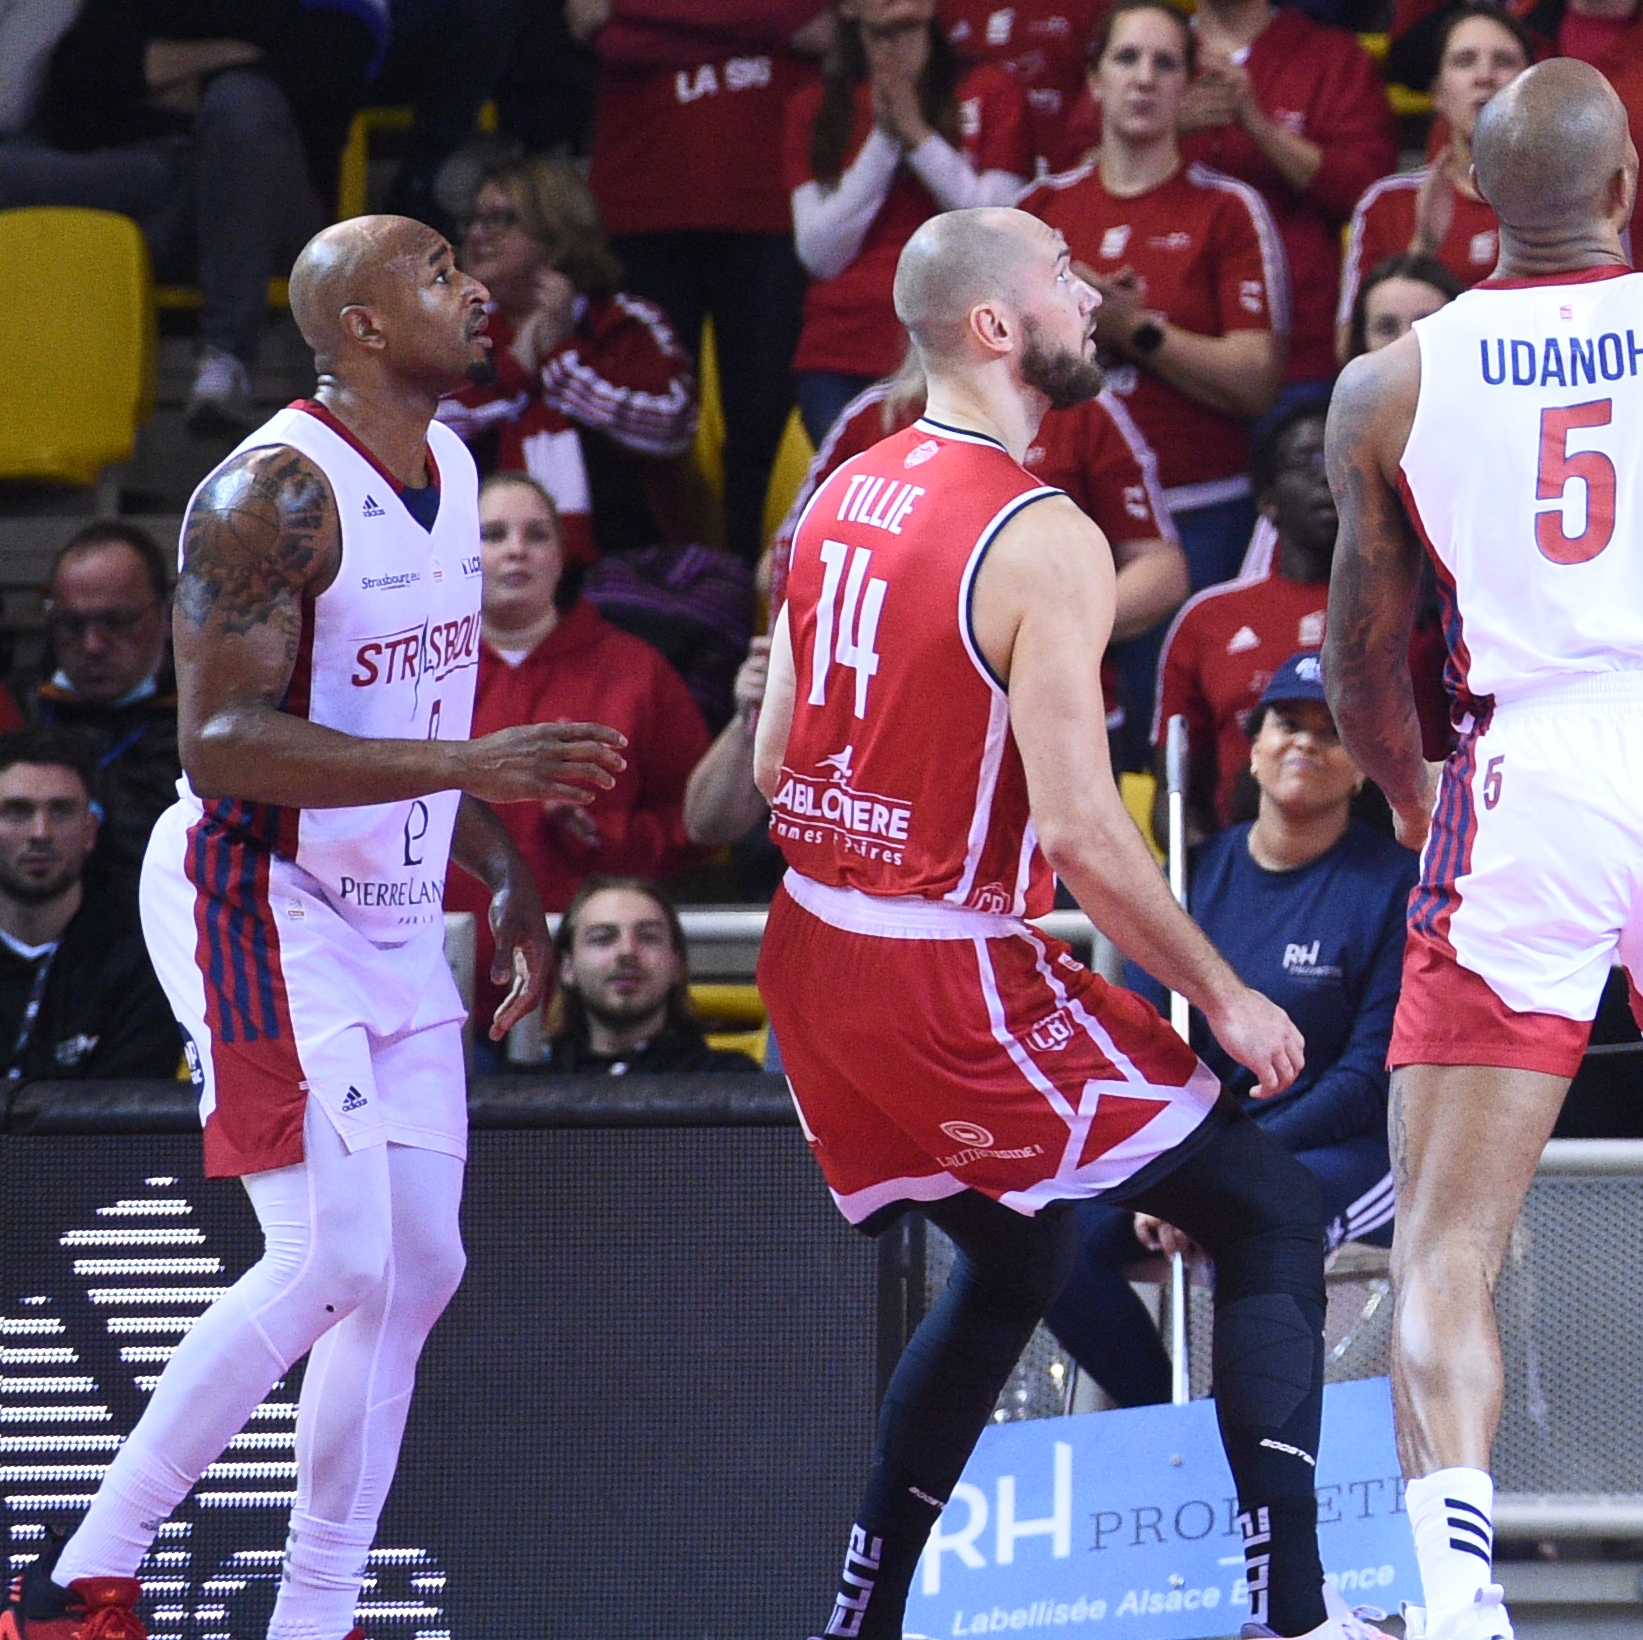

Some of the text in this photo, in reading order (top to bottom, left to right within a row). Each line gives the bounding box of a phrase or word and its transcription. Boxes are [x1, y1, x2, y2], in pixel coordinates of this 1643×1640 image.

[836, 474, 926, 535] TILLIE
[1534, 397, 1618, 566] 5
[807, 539, 888, 720] 14
[1483, 753, 1505, 811] 5
[922, 1440, 1073, 1596] RH
[952, 1593, 1107, 1637] Labellisée
[1115, 1583, 1220, 1619] Alsace
